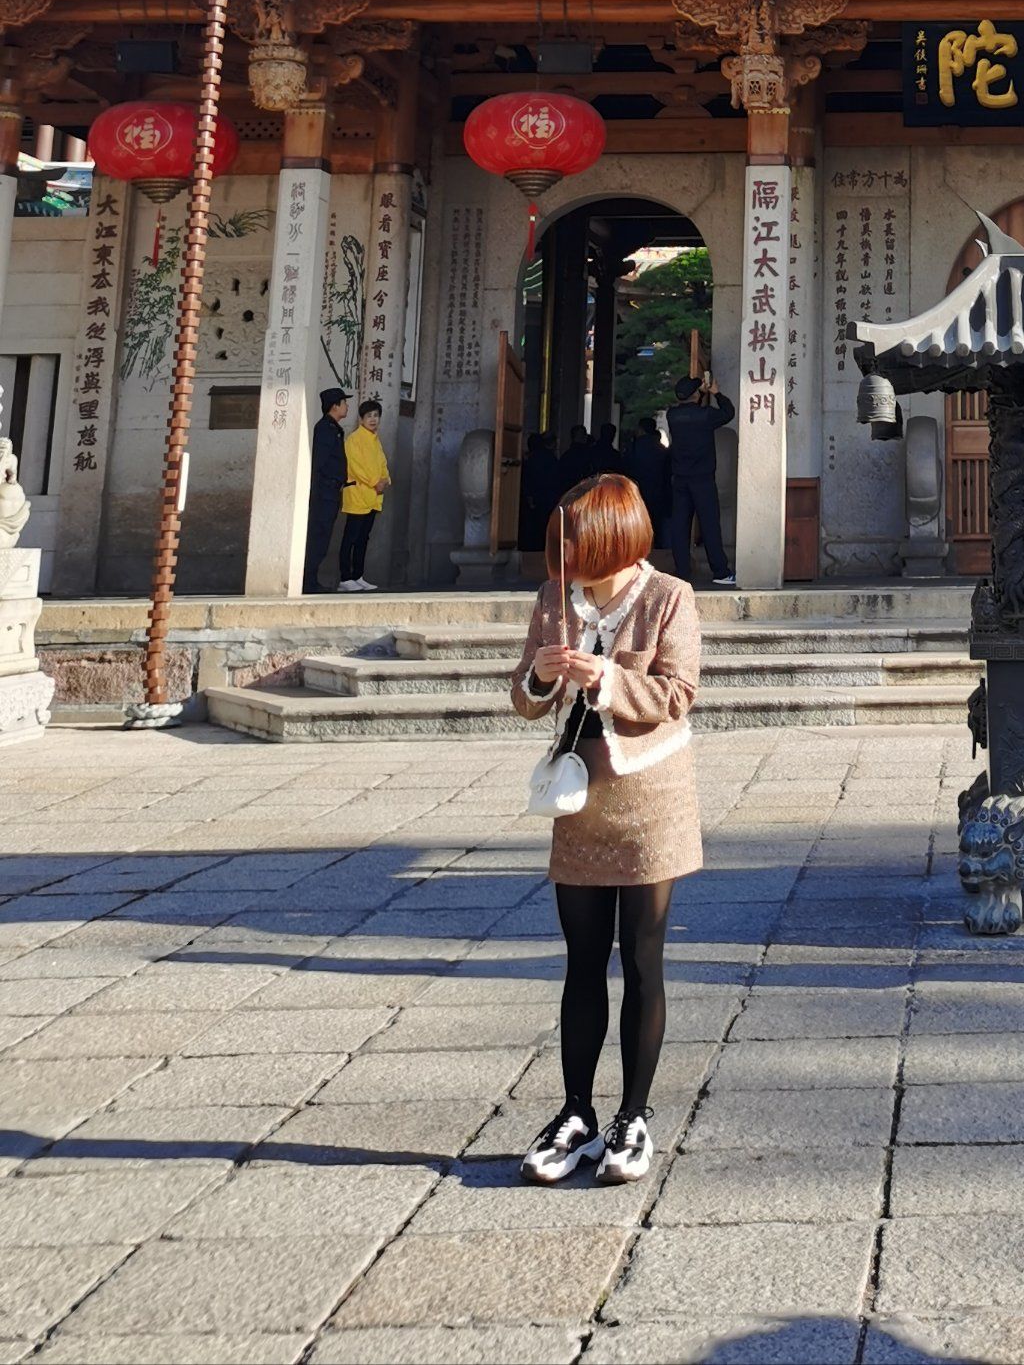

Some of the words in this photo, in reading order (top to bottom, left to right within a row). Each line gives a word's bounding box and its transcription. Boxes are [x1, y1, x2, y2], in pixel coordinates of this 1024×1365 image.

[125, 116, 161, 150] 福
[519, 106, 555, 139] 福
[748, 180, 781, 426] 隔江太武拱山門
